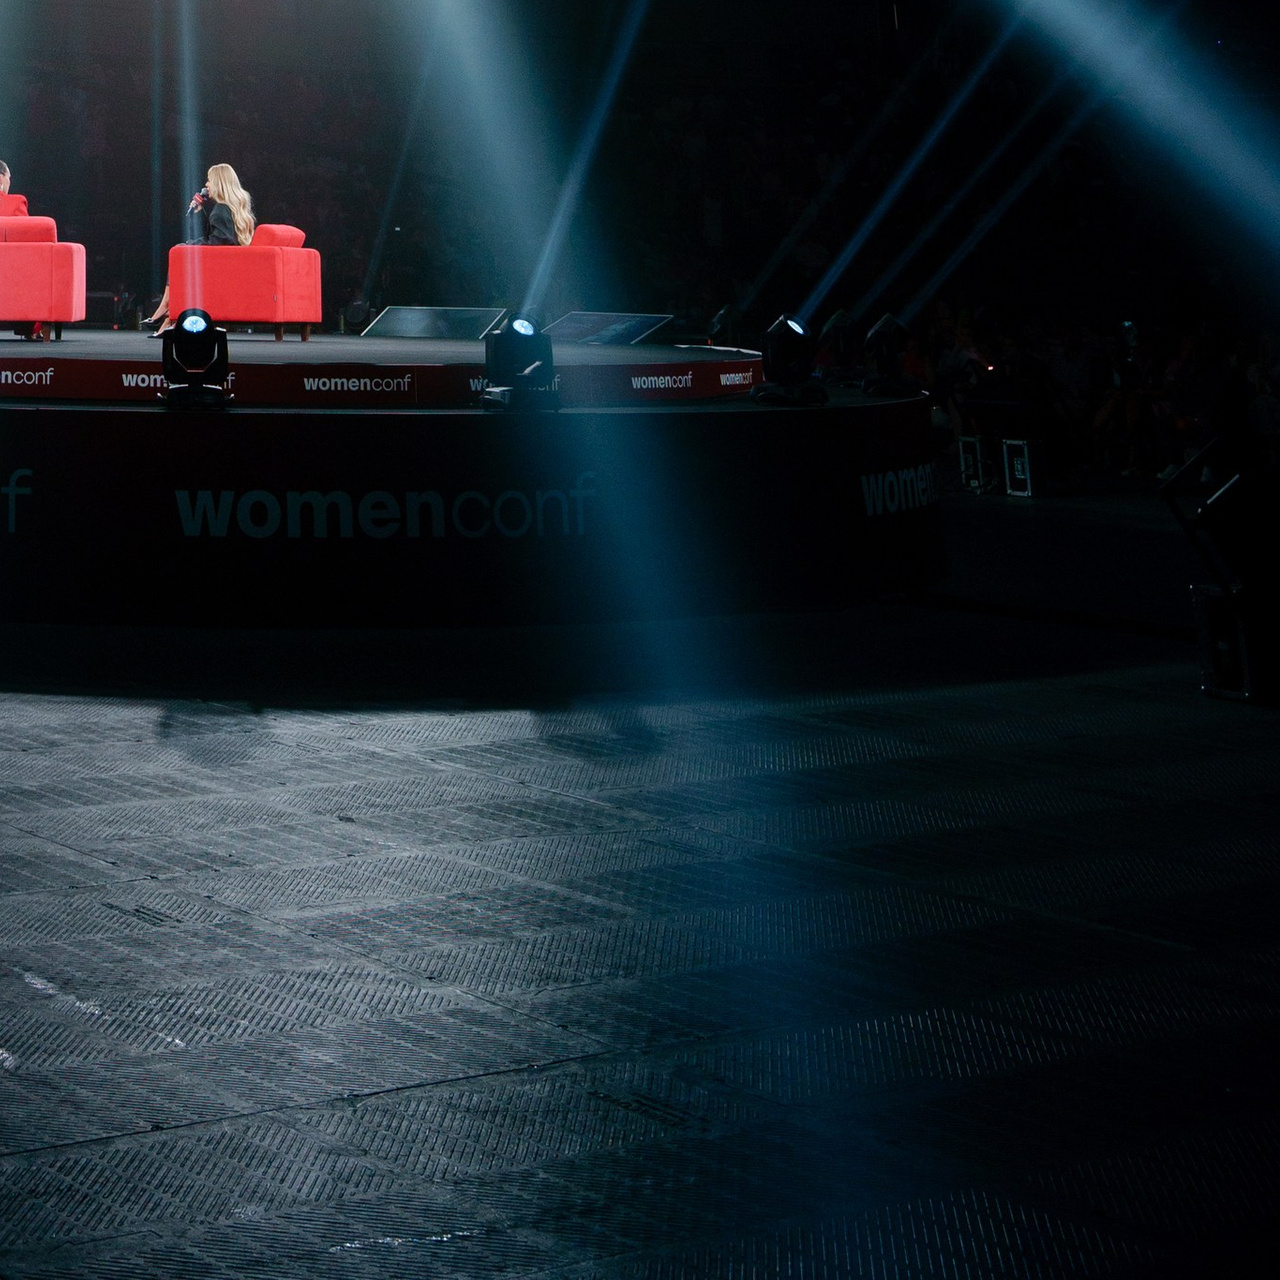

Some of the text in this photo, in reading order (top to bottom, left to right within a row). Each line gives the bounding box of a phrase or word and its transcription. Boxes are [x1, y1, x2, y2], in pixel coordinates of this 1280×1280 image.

[303, 373, 412, 391] womenconf
[631, 370, 693, 390] womenconf
[173, 470, 597, 539] womenconf
